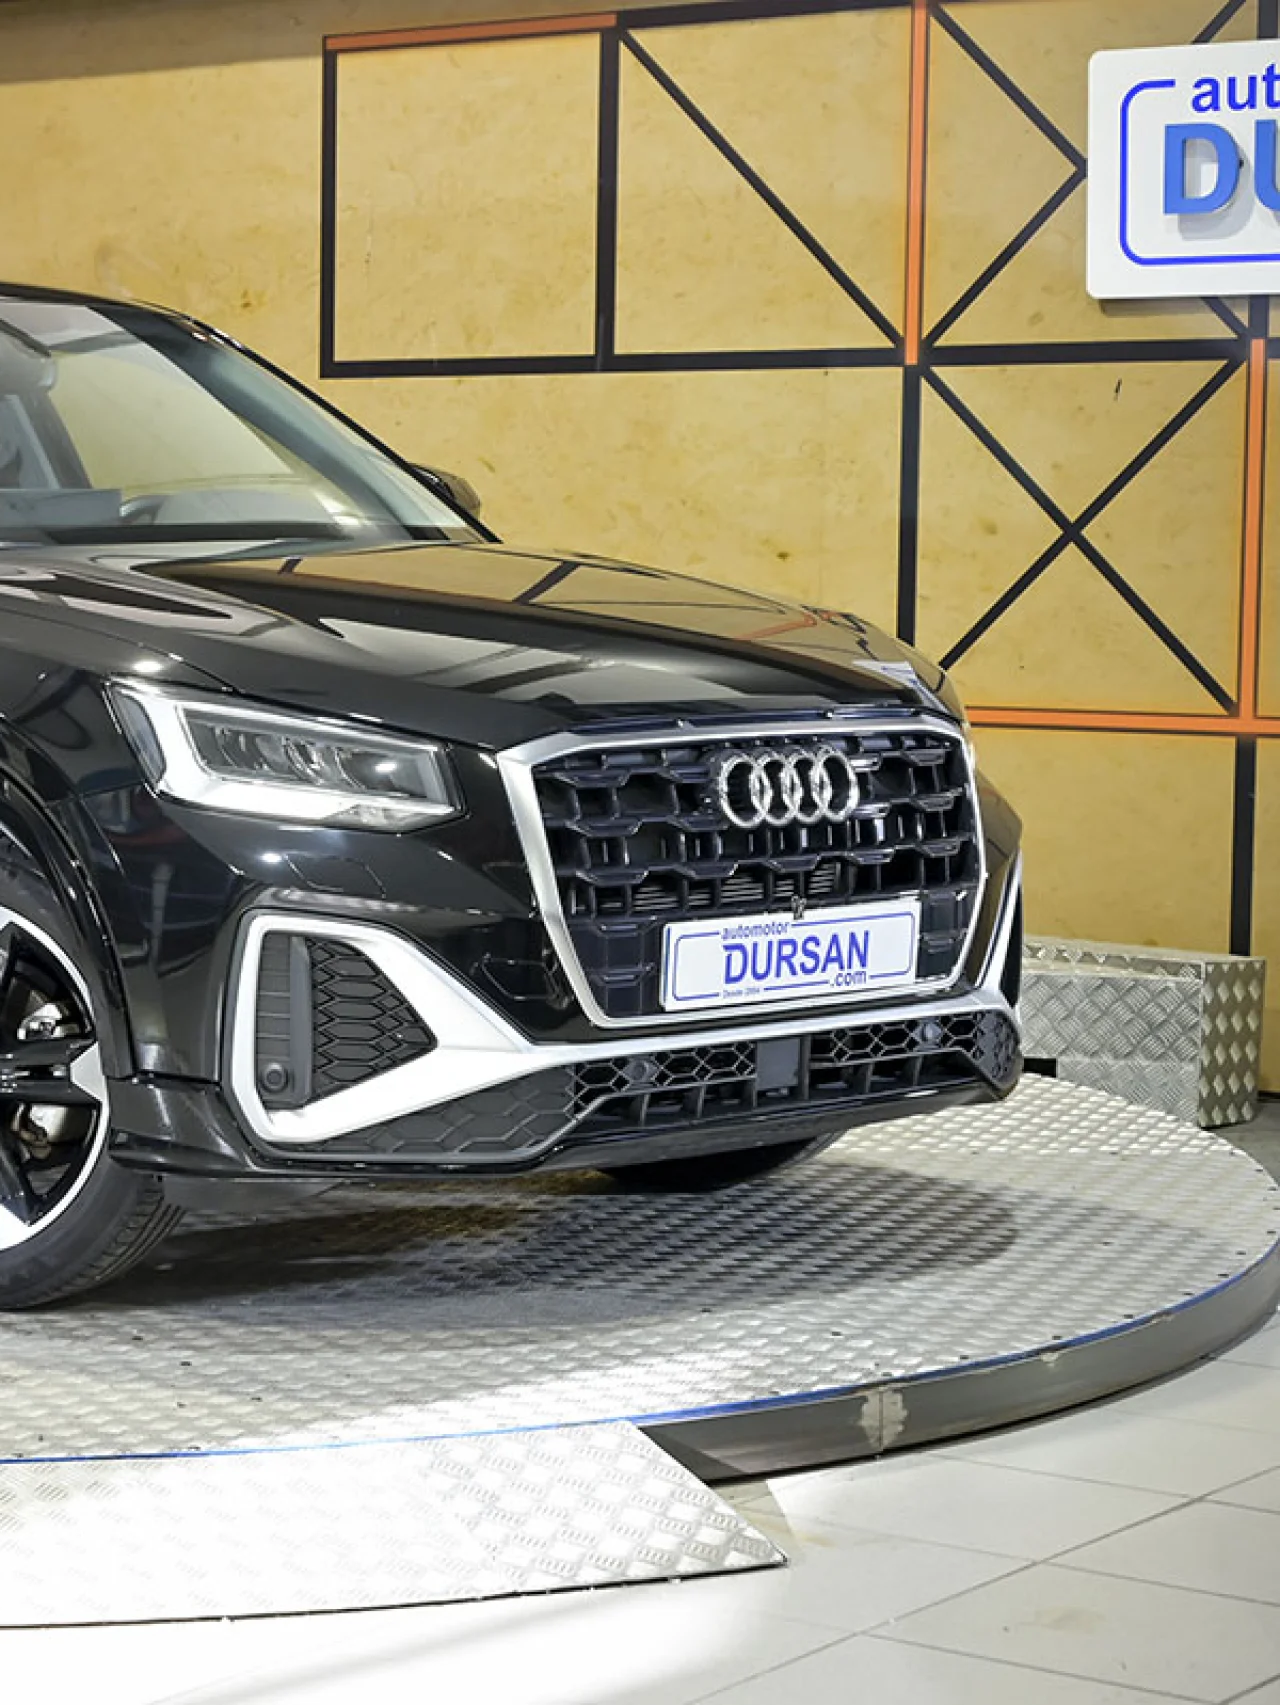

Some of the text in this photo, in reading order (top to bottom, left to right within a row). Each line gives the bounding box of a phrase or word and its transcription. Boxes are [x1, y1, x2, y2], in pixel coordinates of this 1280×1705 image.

[722, 921, 790, 940] automotor
[722, 929, 870, 985] DURSAN
[829, 971, 867, 988] .com
